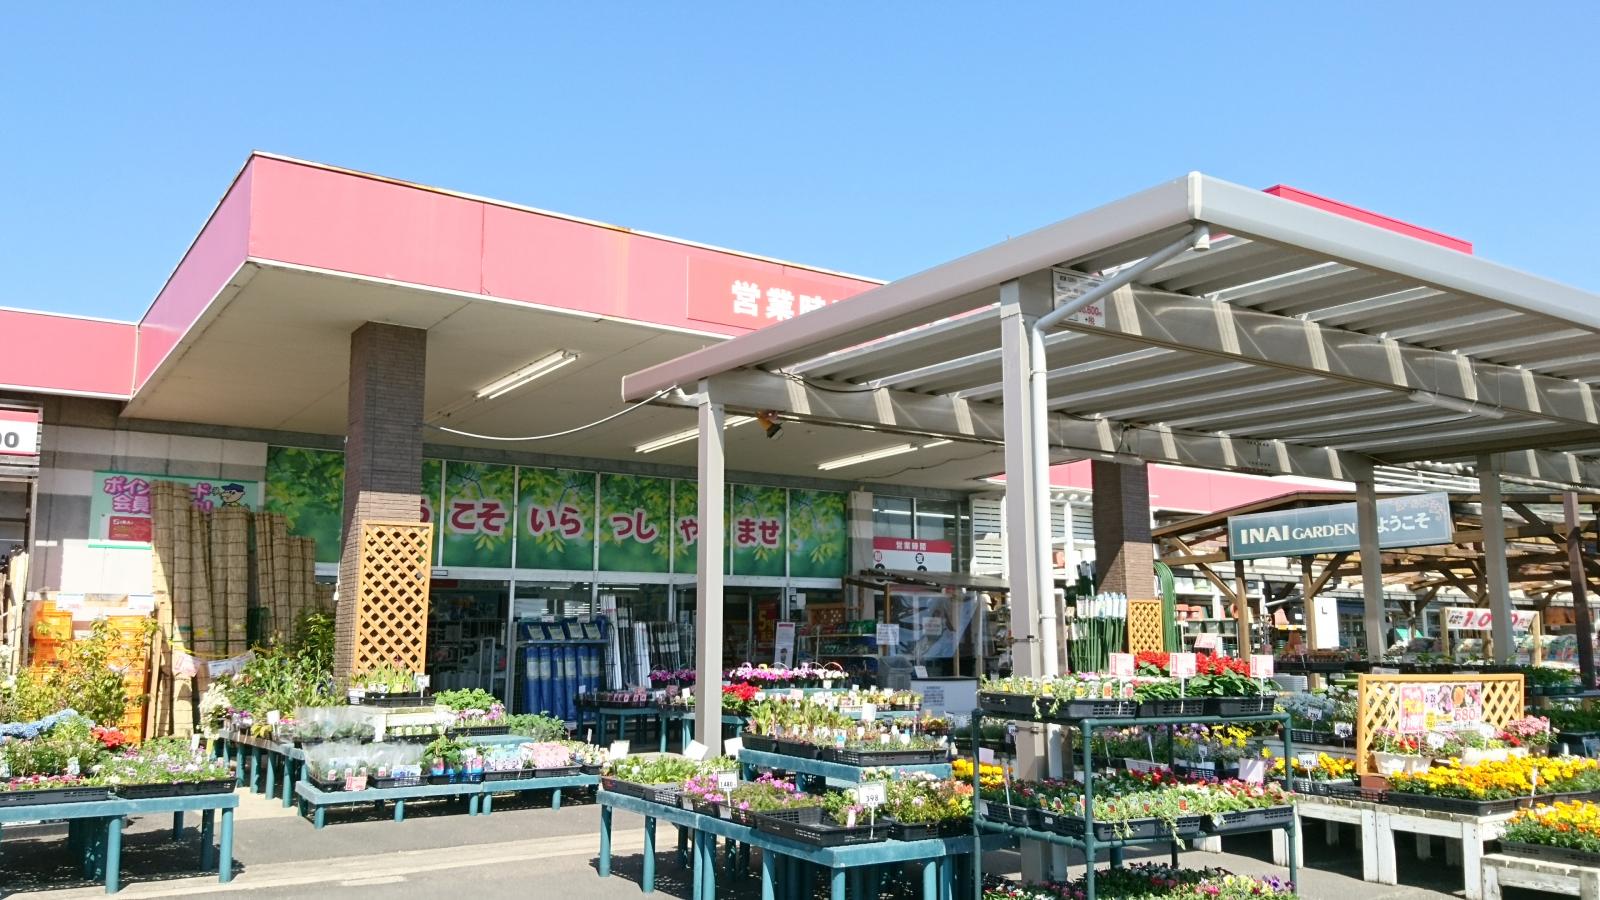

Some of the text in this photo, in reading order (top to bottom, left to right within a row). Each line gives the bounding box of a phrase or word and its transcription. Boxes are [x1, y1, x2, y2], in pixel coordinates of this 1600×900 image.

[1240, 522, 1357, 545] INAI GARDEN
[1376, 511, 1431, 534] ようこそ
